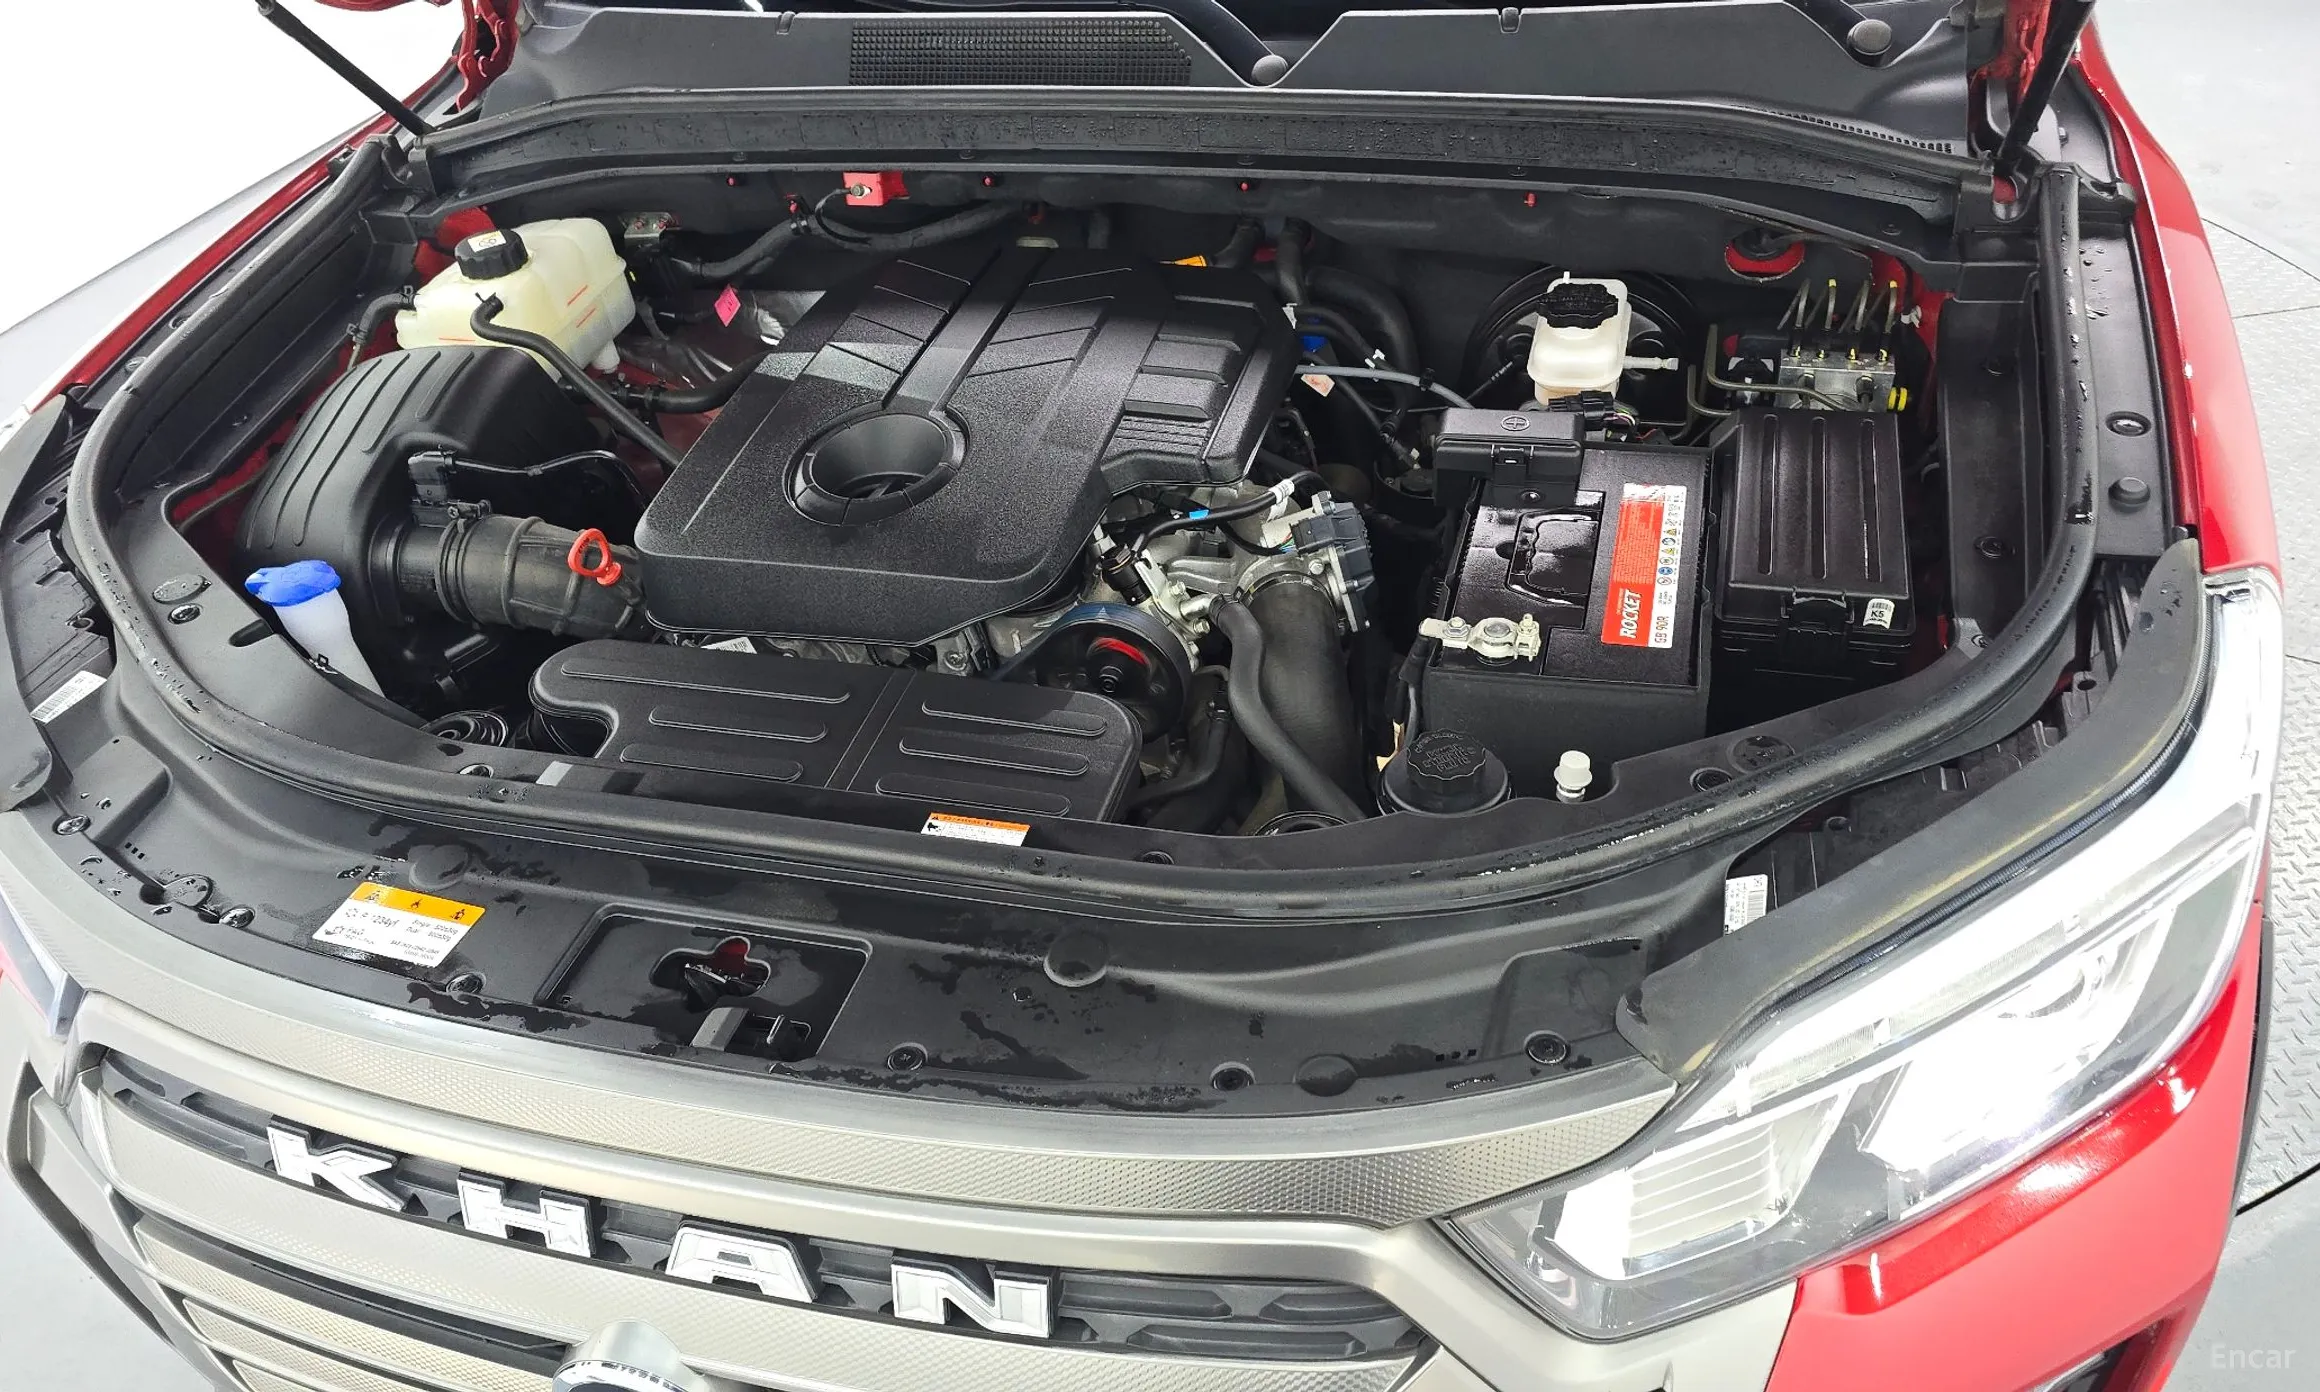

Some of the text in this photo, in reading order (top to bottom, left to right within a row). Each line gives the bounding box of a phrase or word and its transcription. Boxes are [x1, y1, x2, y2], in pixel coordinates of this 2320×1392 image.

[1619, 588, 1642, 638] ROCKET
[1870, 610, 1884, 618] K5
[267, 1115, 1052, 1339] KHAN
